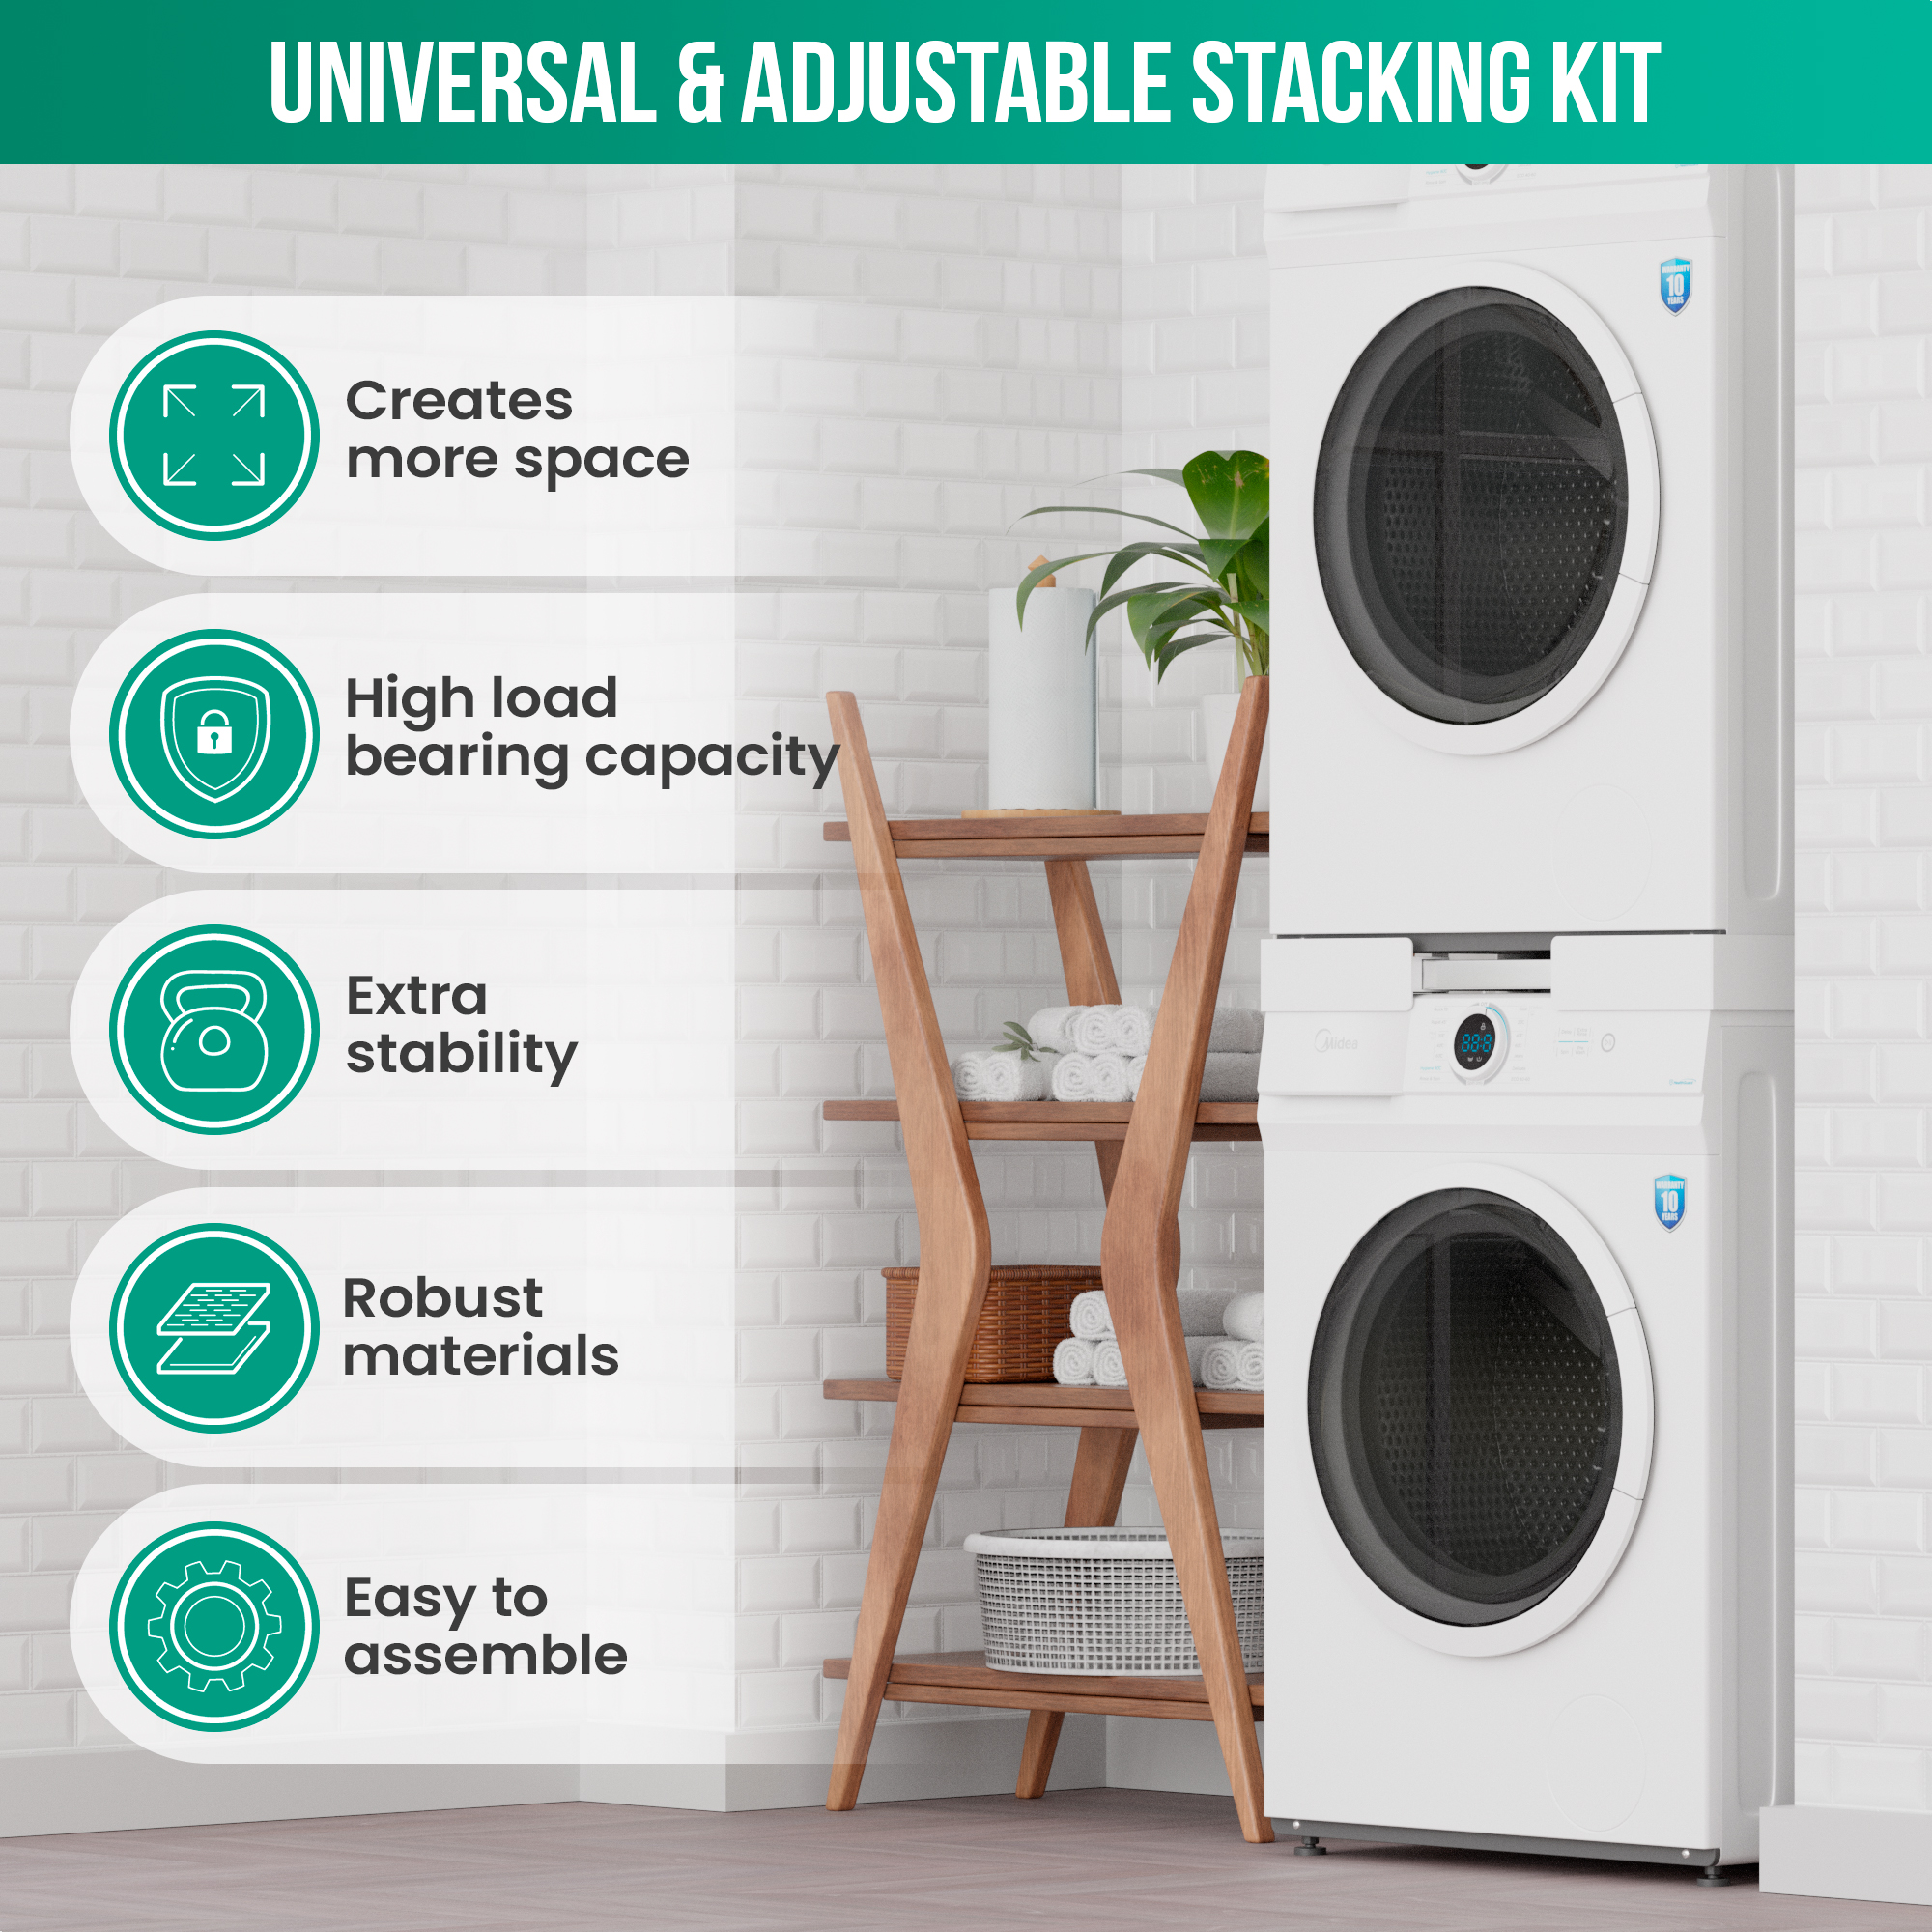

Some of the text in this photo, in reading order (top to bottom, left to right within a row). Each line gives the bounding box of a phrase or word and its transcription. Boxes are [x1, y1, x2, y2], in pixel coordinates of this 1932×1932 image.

[1662, 264, 1690, 273] WARRANTY
[1666, 273, 1685, 297] 10
[1667, 296, 1684, 305] YEARS
[1315, 1028, 1358, 1053] Midea
[1656, 1180, 1684, 1189] WARRANTY
[1661, 1190, 1678, 1212] 10
[1662, 1212, 1678, 1221] YEARS
